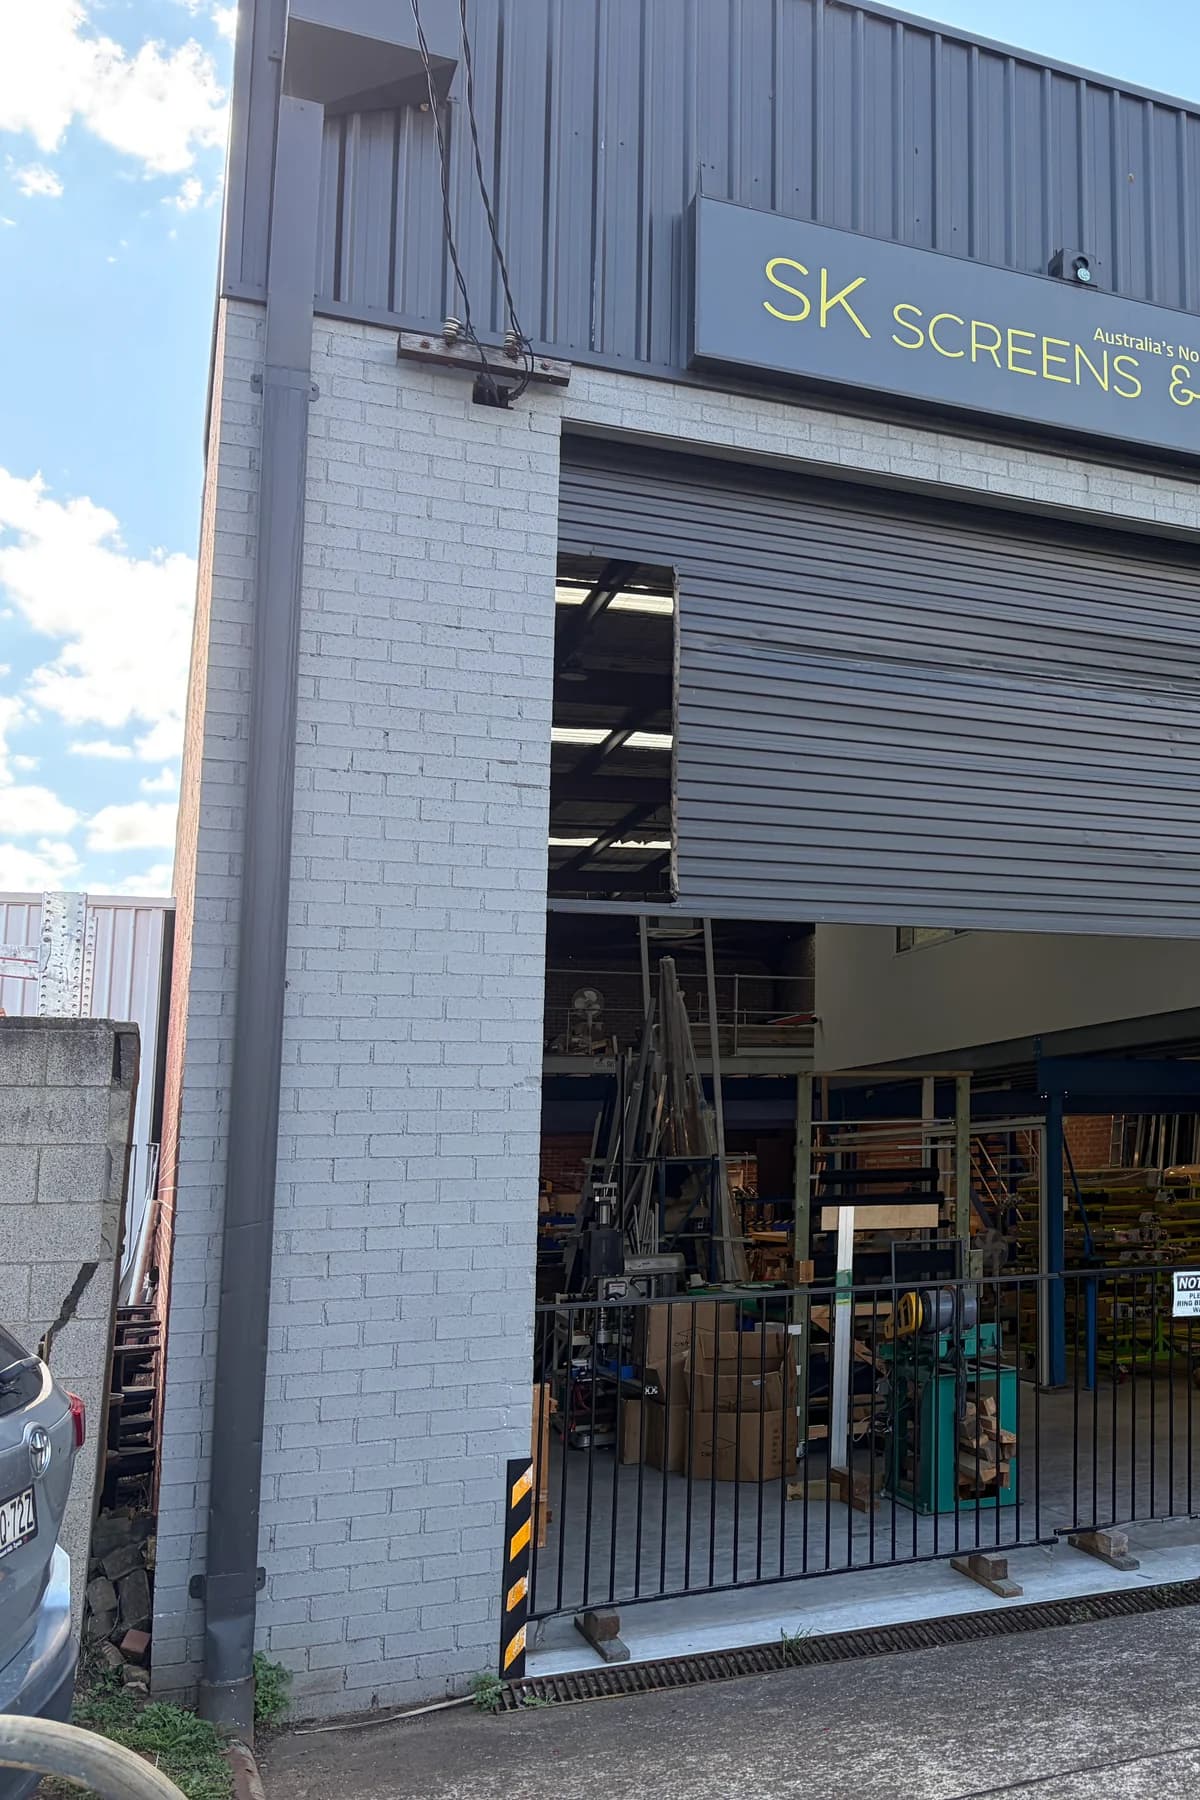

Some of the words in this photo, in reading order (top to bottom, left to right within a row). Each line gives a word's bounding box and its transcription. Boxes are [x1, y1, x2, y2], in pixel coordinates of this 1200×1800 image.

[762, 257, 871, 339] SK
[892, 303, 1142, 398] SCREENS
[1093, 327, 1174, 357] Australia's
